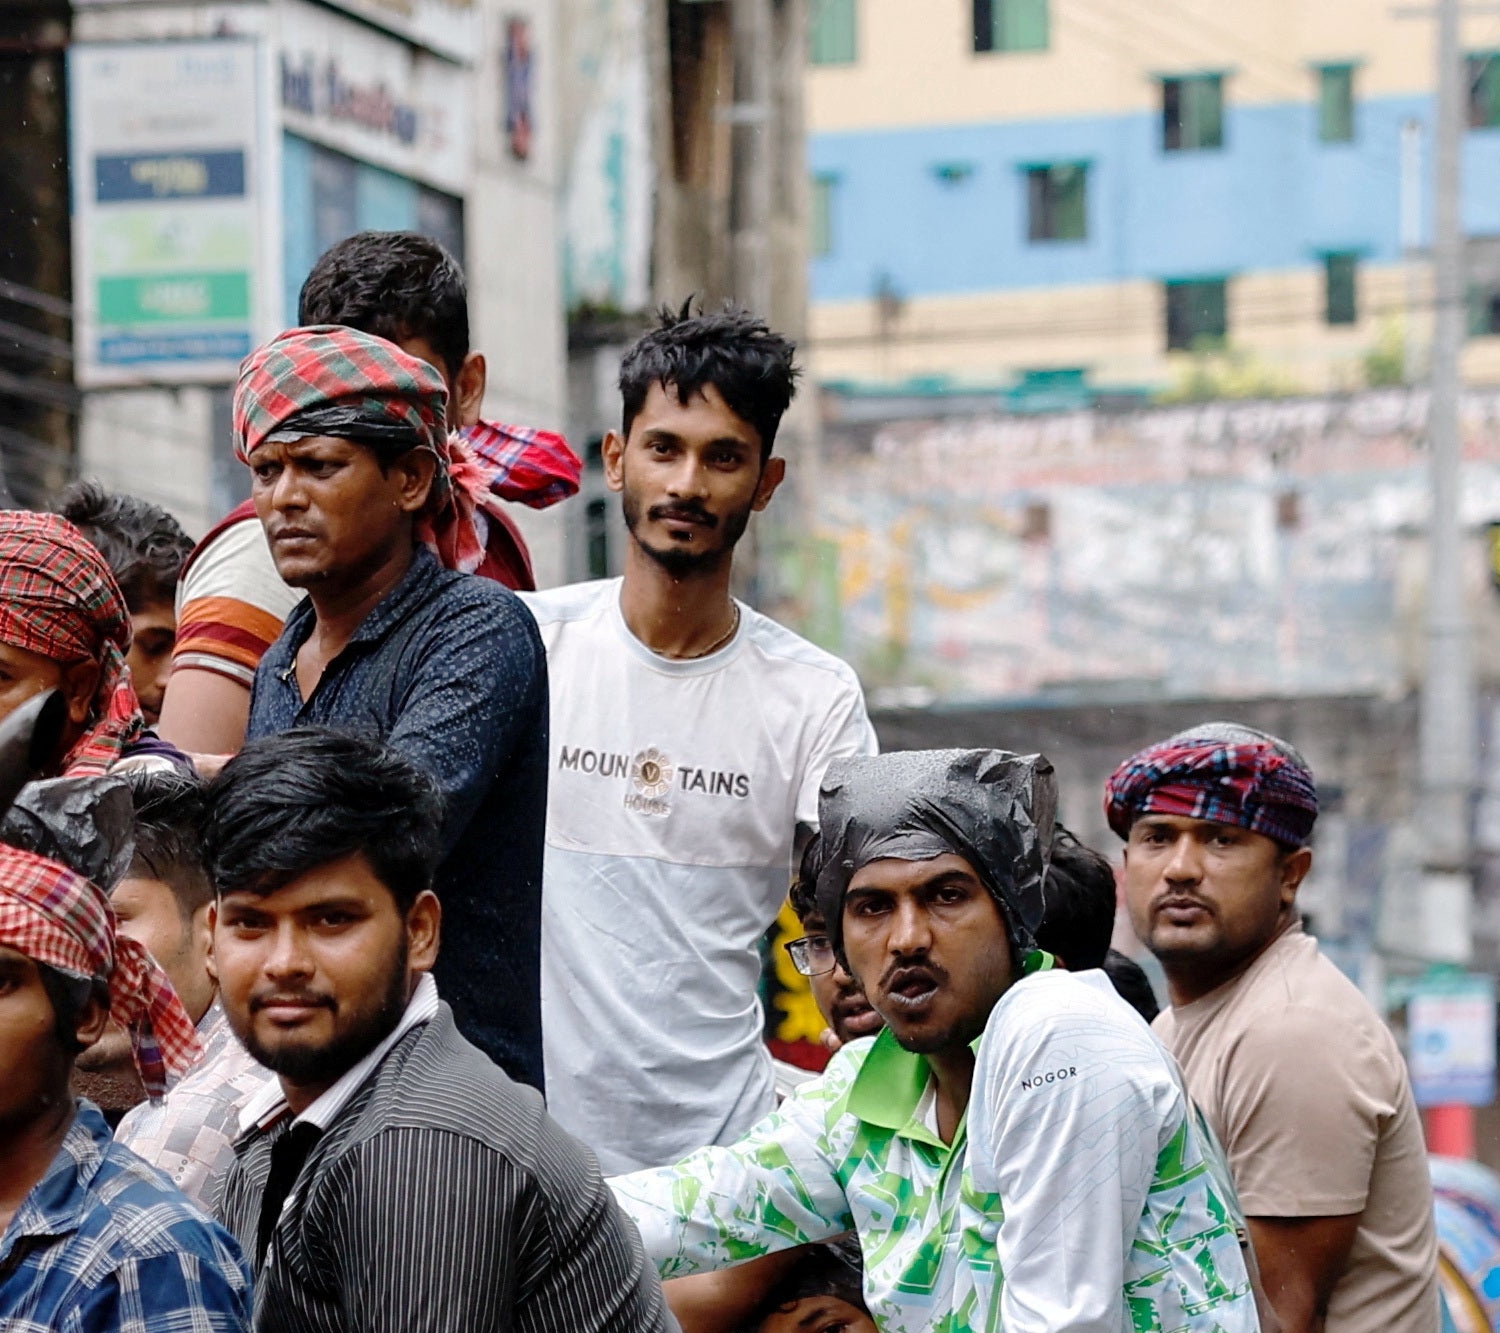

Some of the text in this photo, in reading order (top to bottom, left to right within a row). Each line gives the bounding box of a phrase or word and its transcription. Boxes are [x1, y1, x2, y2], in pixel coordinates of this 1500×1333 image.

[558, 745, 629, 779] MOUN
[677, 766, 750, 799] TAINS
[624, 794, 672, 815] HOUSE
[1021, 1066, 1077, 1091] NOGOR
